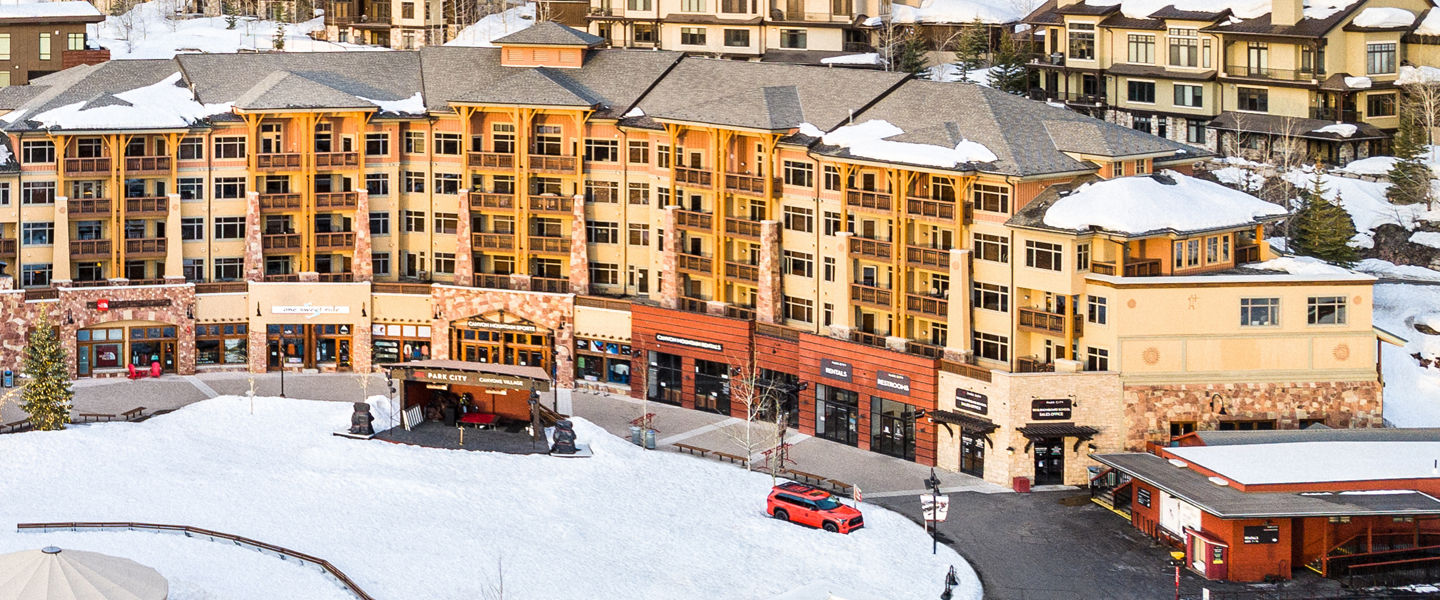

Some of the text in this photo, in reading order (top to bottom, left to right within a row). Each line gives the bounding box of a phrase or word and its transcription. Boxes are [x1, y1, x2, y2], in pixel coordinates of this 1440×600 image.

[427, 372, 467, 382] PARK CITY
[825, 367, 848, 377] RENTALS
[877, 378, 909, 391] RESTROOMS
